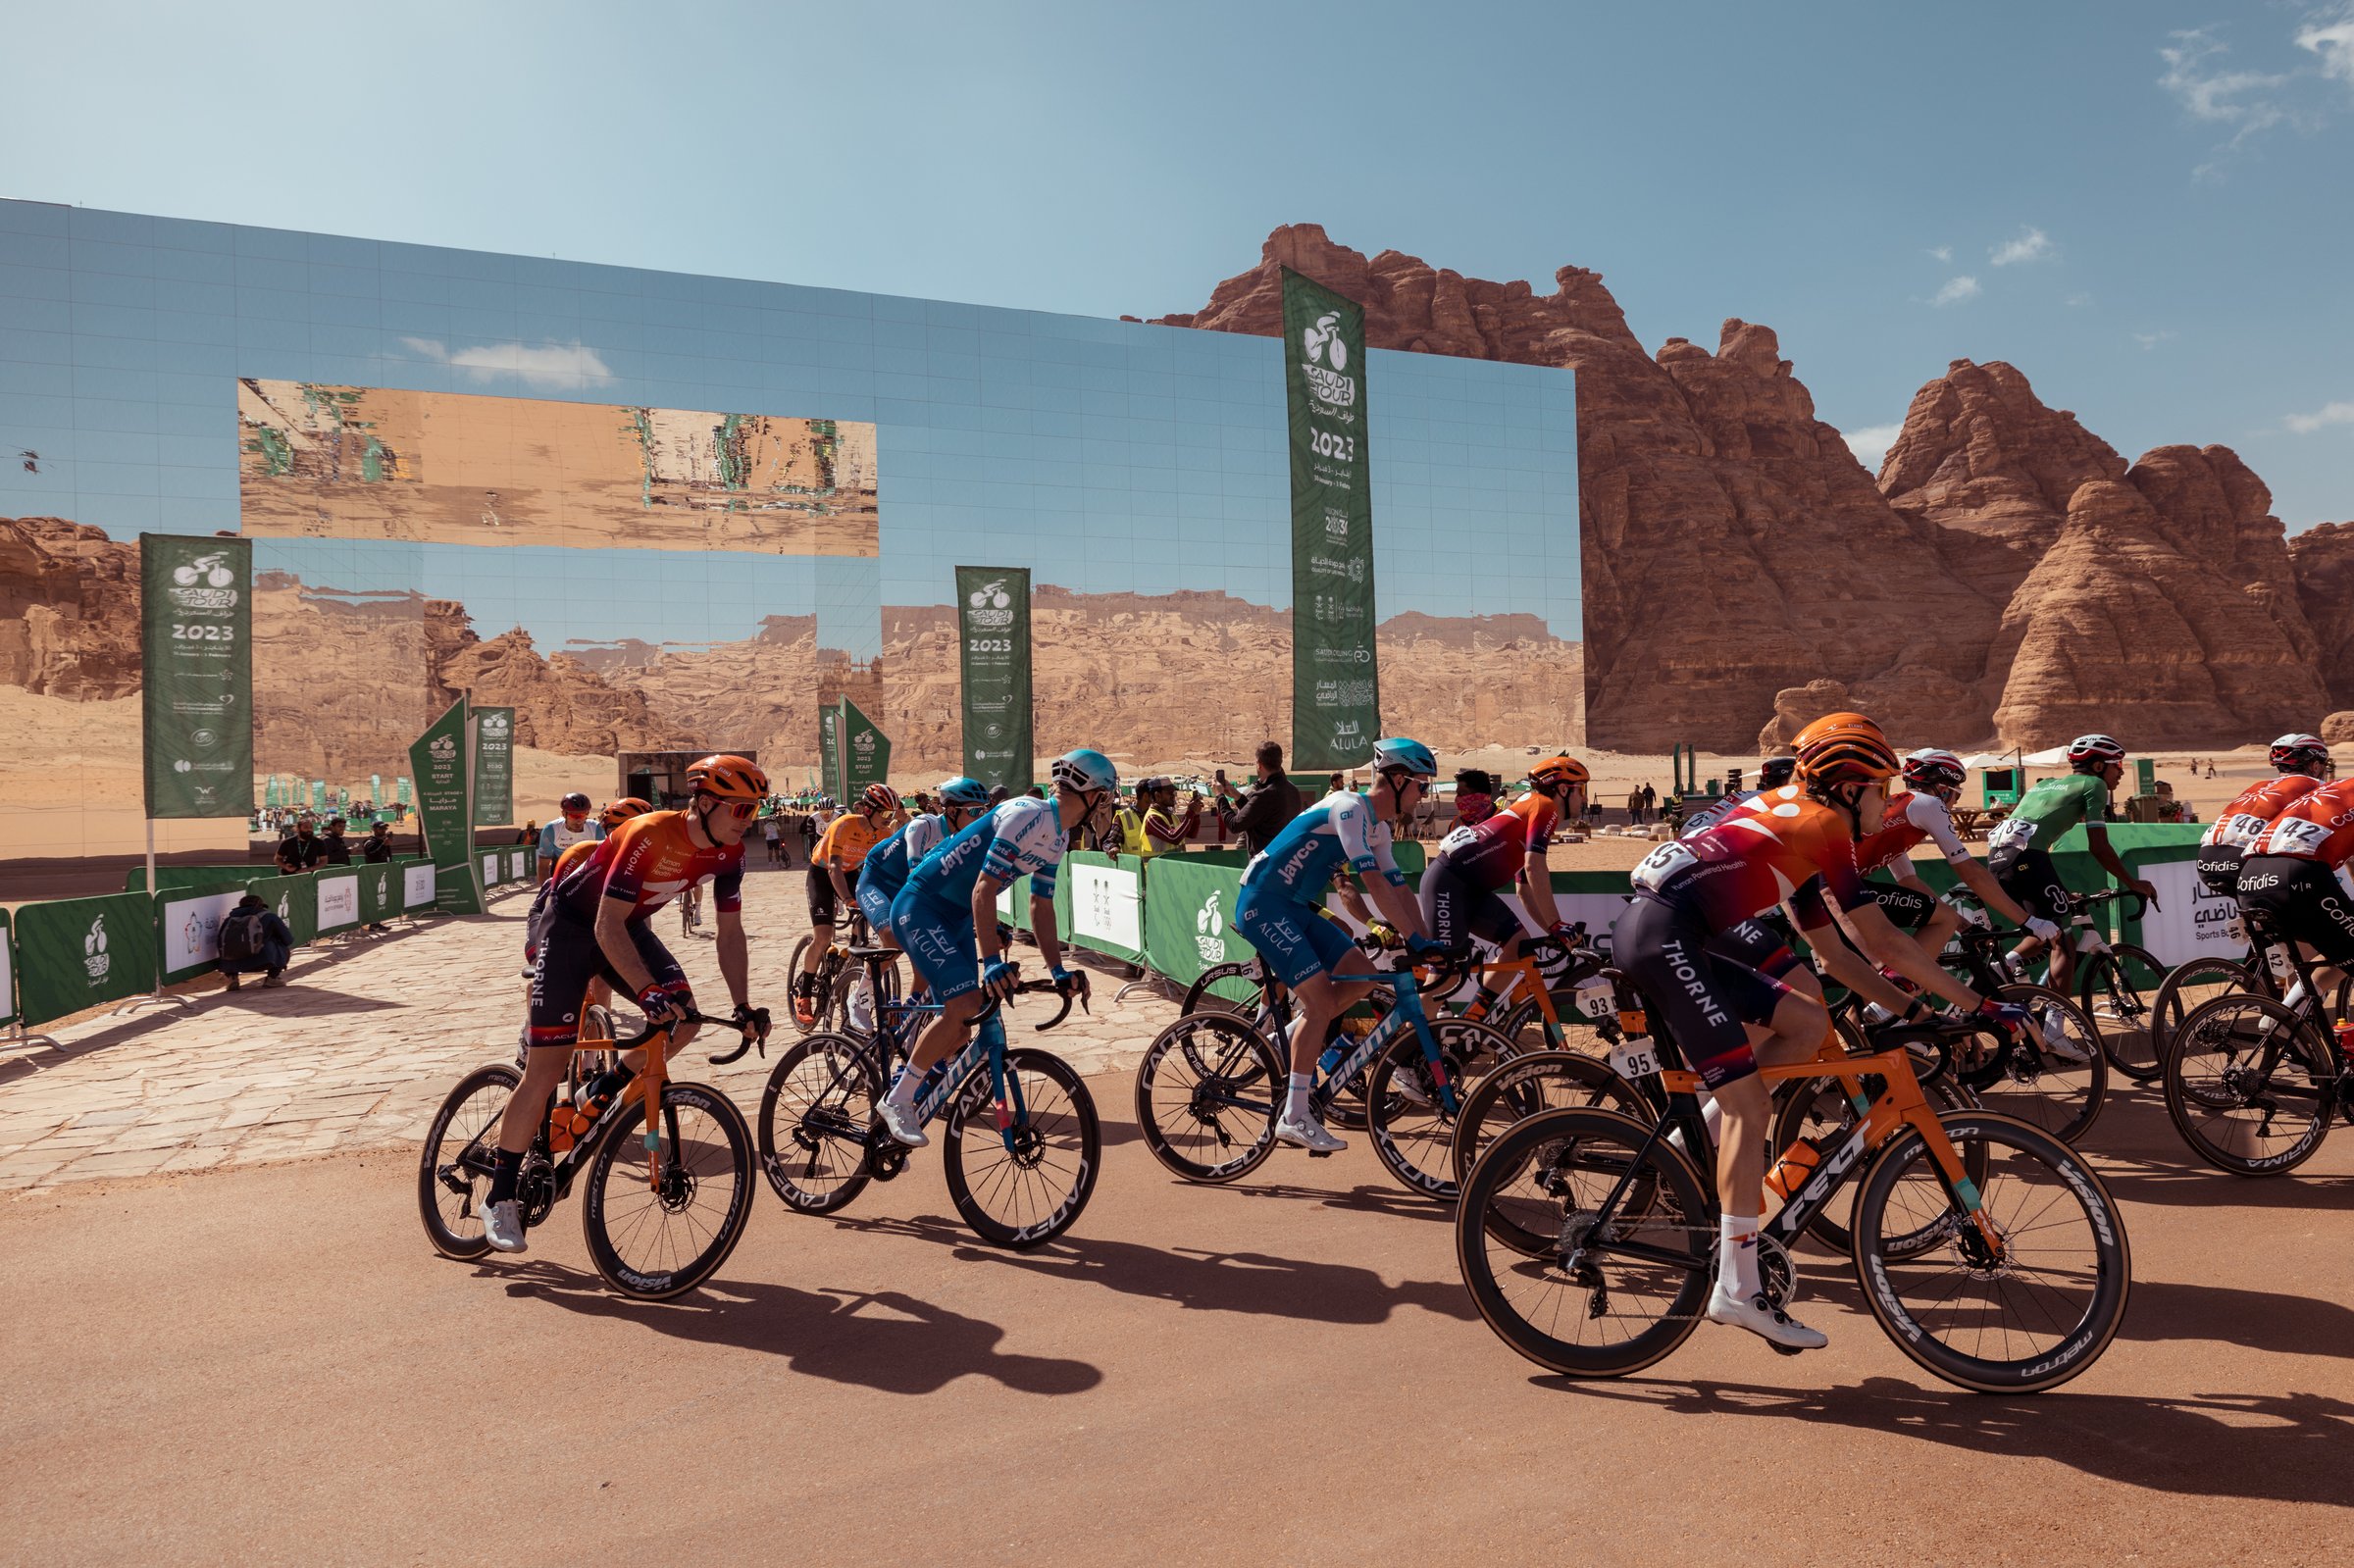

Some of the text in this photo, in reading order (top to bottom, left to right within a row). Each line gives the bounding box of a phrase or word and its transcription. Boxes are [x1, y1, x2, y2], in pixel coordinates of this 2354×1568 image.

[1310, 368, 1352, 391] SAUDI
[1313, 381, 1352, 406] TOUR
[1310, 427, 1354, 462] 2023
[179, 589, 232, 599] SAUDI
[187, 598, 232, 608] TOUR
[172, 624, 234, 640] 2023
[980, 617, 1010, 626] TOUR
[969, 639, 1011, 652] 2023
[482, 742, 507, 751] 2023
[1329, 735, 1368, 750] ALULA
[1015, 811, 1043, 842] GIANT
[1543, 810, 1559, 838] THORNE
[2235, 816, 2265, 835] 46
[2283, 820, 2321, 841] 42
[624, 836, 652, 876] THORNE
[941, 835, 982, 876] Jayco
[1017, 850, 1048, 868] Jayc
[1277, 838, 1320, 885] Jayco
[1951, 847, 1967, 857] LO
[2197, 859, 2239, 872] Cofidis
[1670, 859, 1747, 891] Human Powered Health
[2237, 873, 2278, 891] Cofidis
[1435, 892, 1452, 946] THORNE
[2229, 923, 2241, 939] 46
[2321, 897, 2354, 937] Cofi
[909, 928, 946, 970] ALULA
[1199, 936, 1222, 950] SAUDI
[1258, 922, 1294, 958] ALULA
[2196, 929, 2219, 941] Sports
[1202, 947, 1222, 962] TOUR
[1243, 962, 1254, 976] 16
[2270, 953, 2283, 968] 42
[531, 937, 549, 1007] THORNE
[661, 979, 689, 988] PACTI
[943, 979, 977, 996] CADEX
[1201, 966, 1237, 986] URSUS
[1662, 939, 1728, 1027] THORNE
[859, 991, 869, 1005] 14
[1589, 996, 1609, 1016] 93
[1510, 1008, 1534, 1041] etron
[2031, 994, 2097, 1056] CORIMA
[2185, 1004, 2262, 1048] CORIMA
[1142, 1019, 1210, 1090] CADEX
[1329, 1011, 1395, 1096] GIANT
[1440, 1025, 1518, 1063] CADE
[1496, 1062, 1562, 1090] vision
[1628, 1053, 1650, 1075] 95
[487, 1074, 516, 1088] metro
[915, 1051, 976, 1125] GIANT
[951, 1056, 1021, 1139] CADX
[424, 1108, 448, 1169] vision
[568, 1102, 618, 1164] FELT
[1904, 1127, 1979, 1161] meron
[2246, 1116, 2321, 1168] CORIMA
[1207, 1127, 1273, 1177] ADEX
[590, 1152, 607, 1219] metron
[764, 1155, 833, 1209] CADEX
[1782, 1119, 1870, 1231] FELT
[719, 1172, 742, 1240] metron
[1012, 1159, 1089, 1242] CADEX
[2057, 1159, 2114, 1247] vision
[1887, 1216, 1952, 1252] vision
[617, 1268, 673, 1290] vision
[1869, 1253, 1923, 1343] vision
[2021, 1330, 2093, 1380] metron
